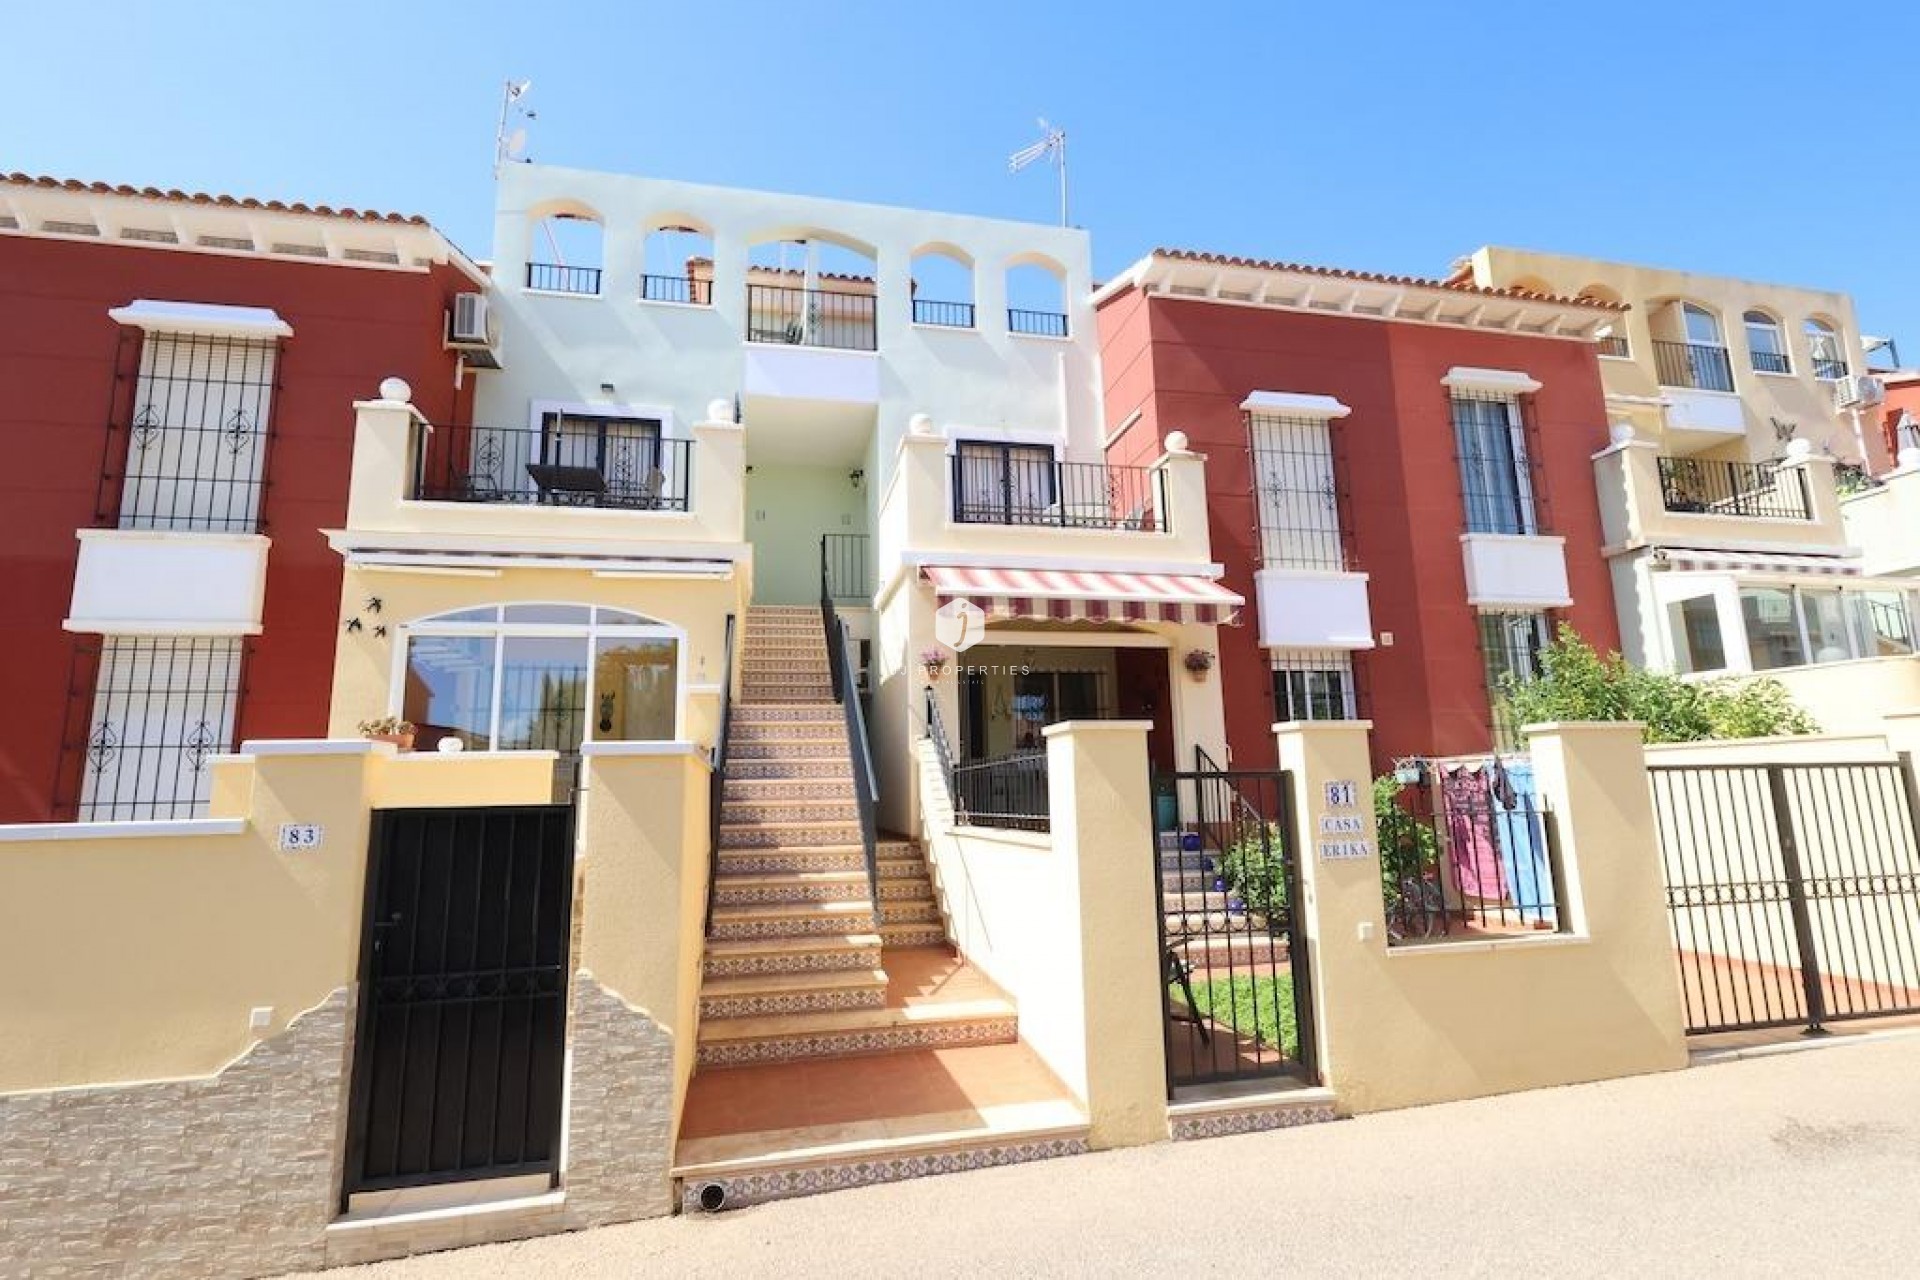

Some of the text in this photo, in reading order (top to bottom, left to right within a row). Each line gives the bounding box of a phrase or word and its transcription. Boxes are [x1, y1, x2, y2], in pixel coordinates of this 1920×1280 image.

[1330, 784, 1349, 804] 81
[1324, 818, 1360, 831] CASA
[289, 828, 314, 844] 83
[1323, 843, 1368, 857] ERIKA
